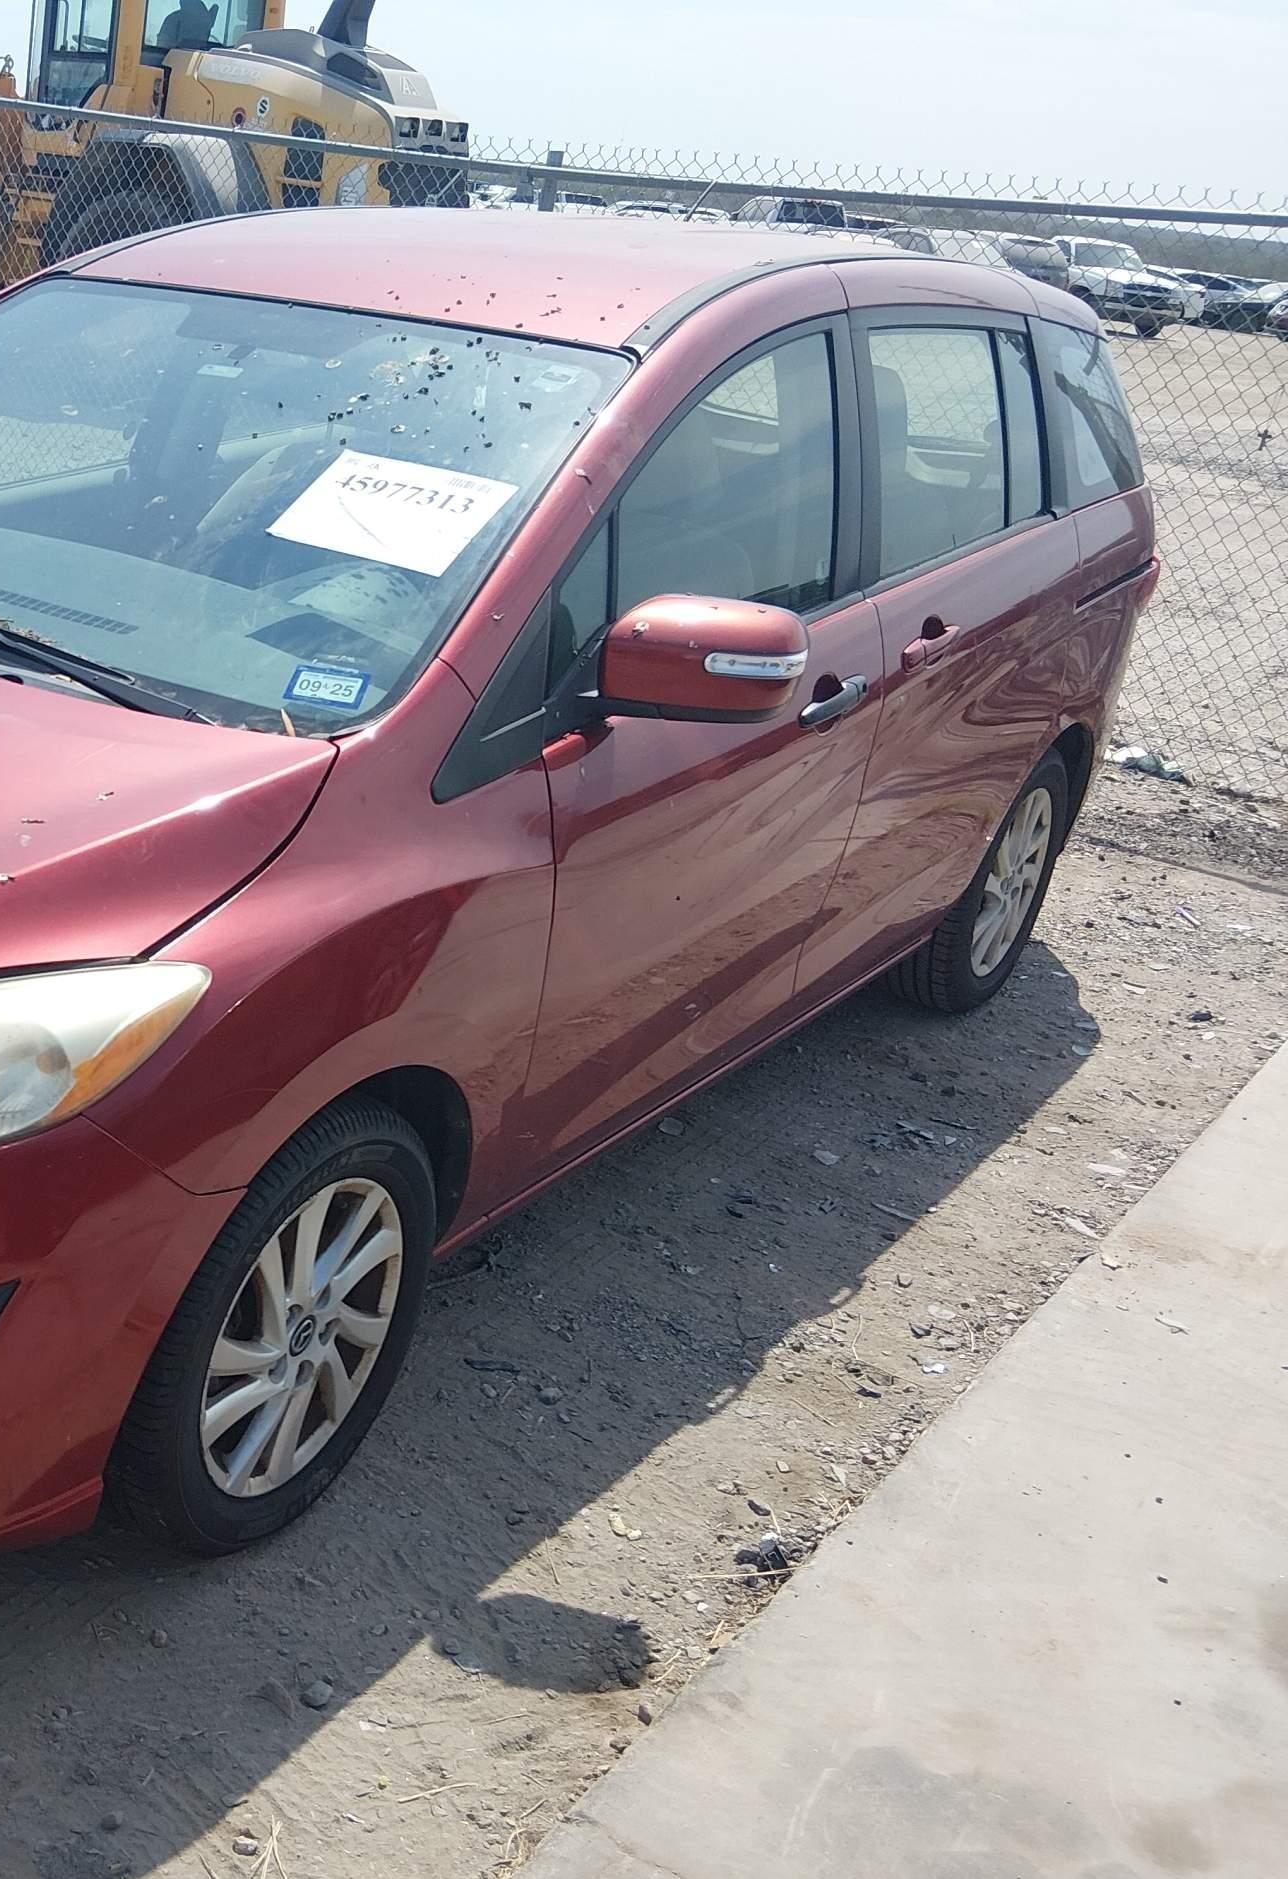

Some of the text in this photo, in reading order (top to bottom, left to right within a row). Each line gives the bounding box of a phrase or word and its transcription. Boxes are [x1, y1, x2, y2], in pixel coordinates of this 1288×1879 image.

[335, 474, 475, 514] 45977313
[299, 679, 355, 697] 09 25
